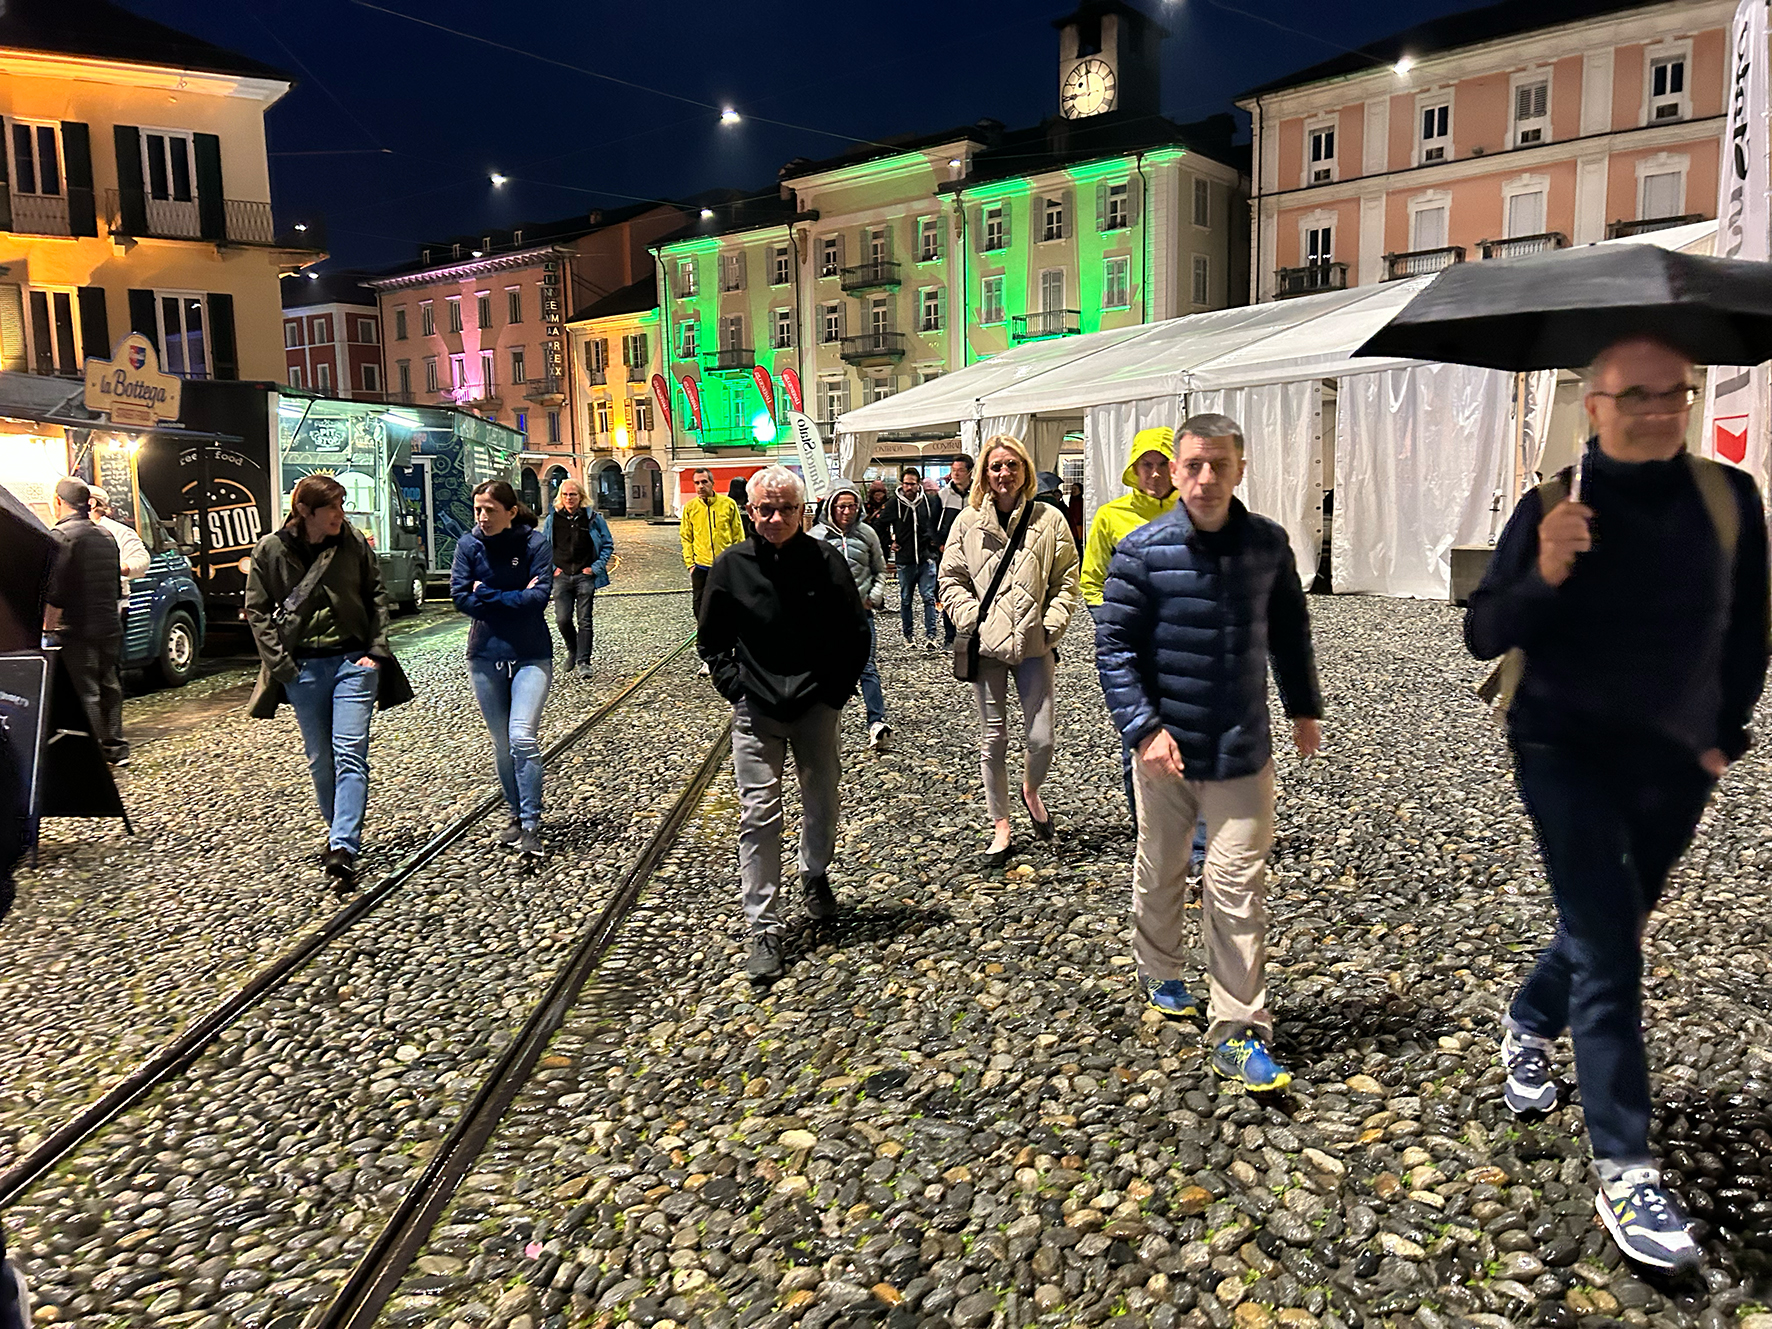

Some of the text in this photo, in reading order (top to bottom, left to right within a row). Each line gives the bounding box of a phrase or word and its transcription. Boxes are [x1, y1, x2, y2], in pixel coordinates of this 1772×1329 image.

[113, 368, 168, 408] Bottega
[214, 450, 244, 466] food
[207, 506, 262, 548] STOP
